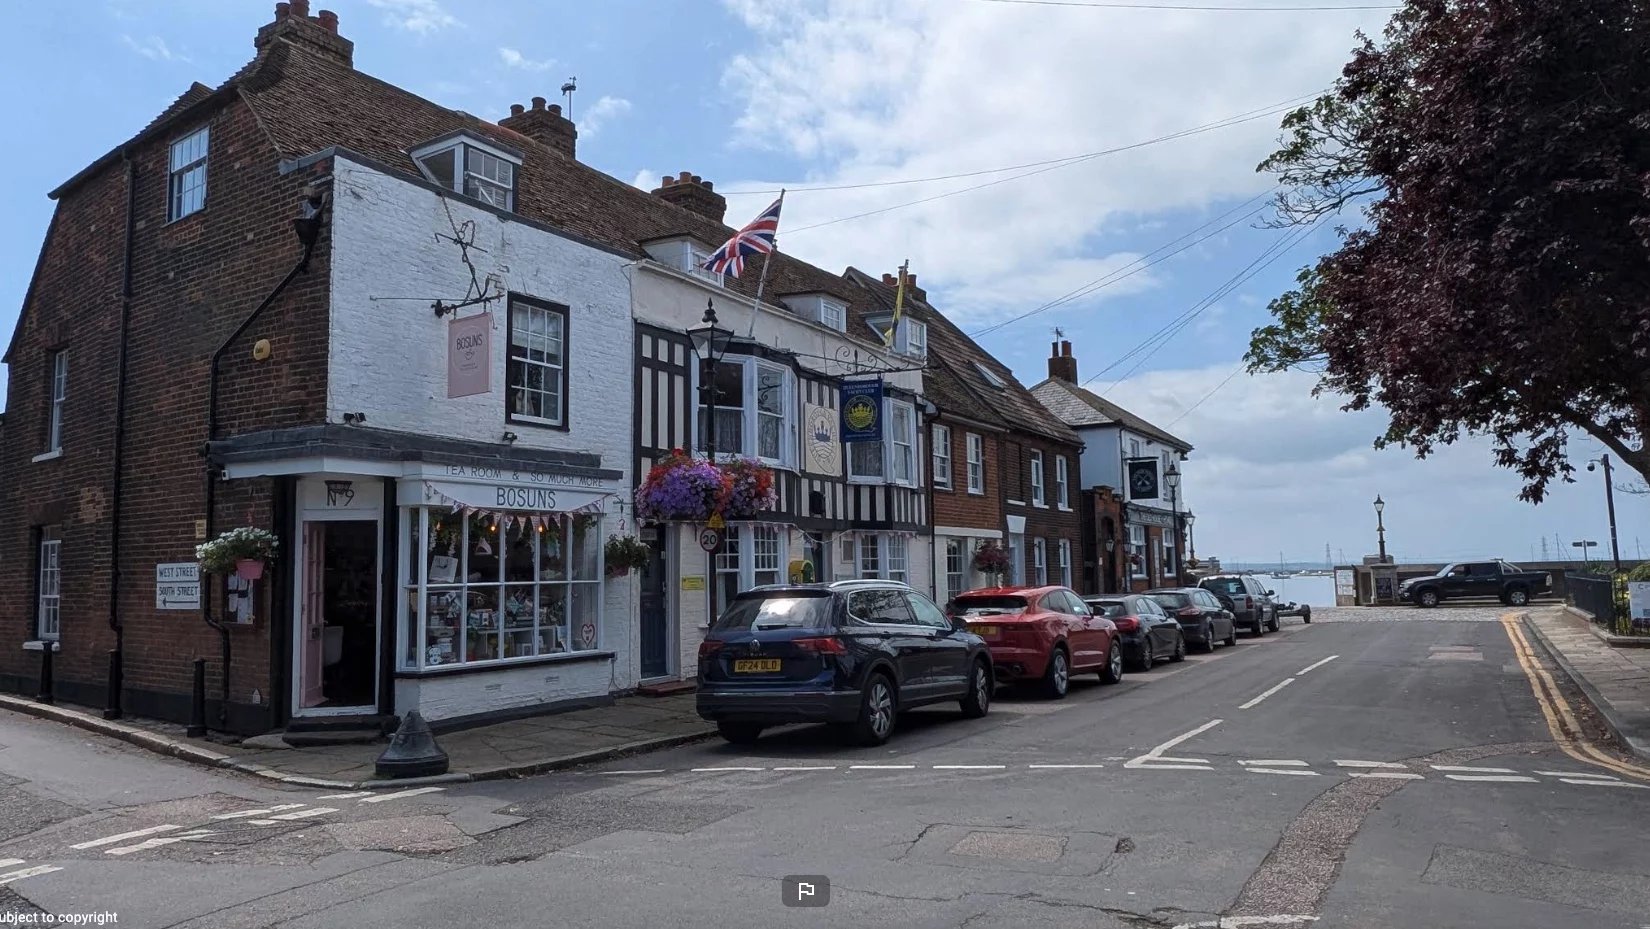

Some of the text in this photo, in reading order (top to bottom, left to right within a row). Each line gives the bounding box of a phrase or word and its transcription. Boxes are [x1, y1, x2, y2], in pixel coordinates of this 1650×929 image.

[457, 334, 483, 350] BOSUNS
[445, 464, 603, 487] TEA ROOM & SO MUCH MORE
[496, 486, 556, 509] BOSUNS
[702, 534, 717, 545] 20
[158, 566, 197, 578] WEST STREET
[159, 586, 199, 597] SOUTH STREET
[737, 660, 759, 670] GF24
